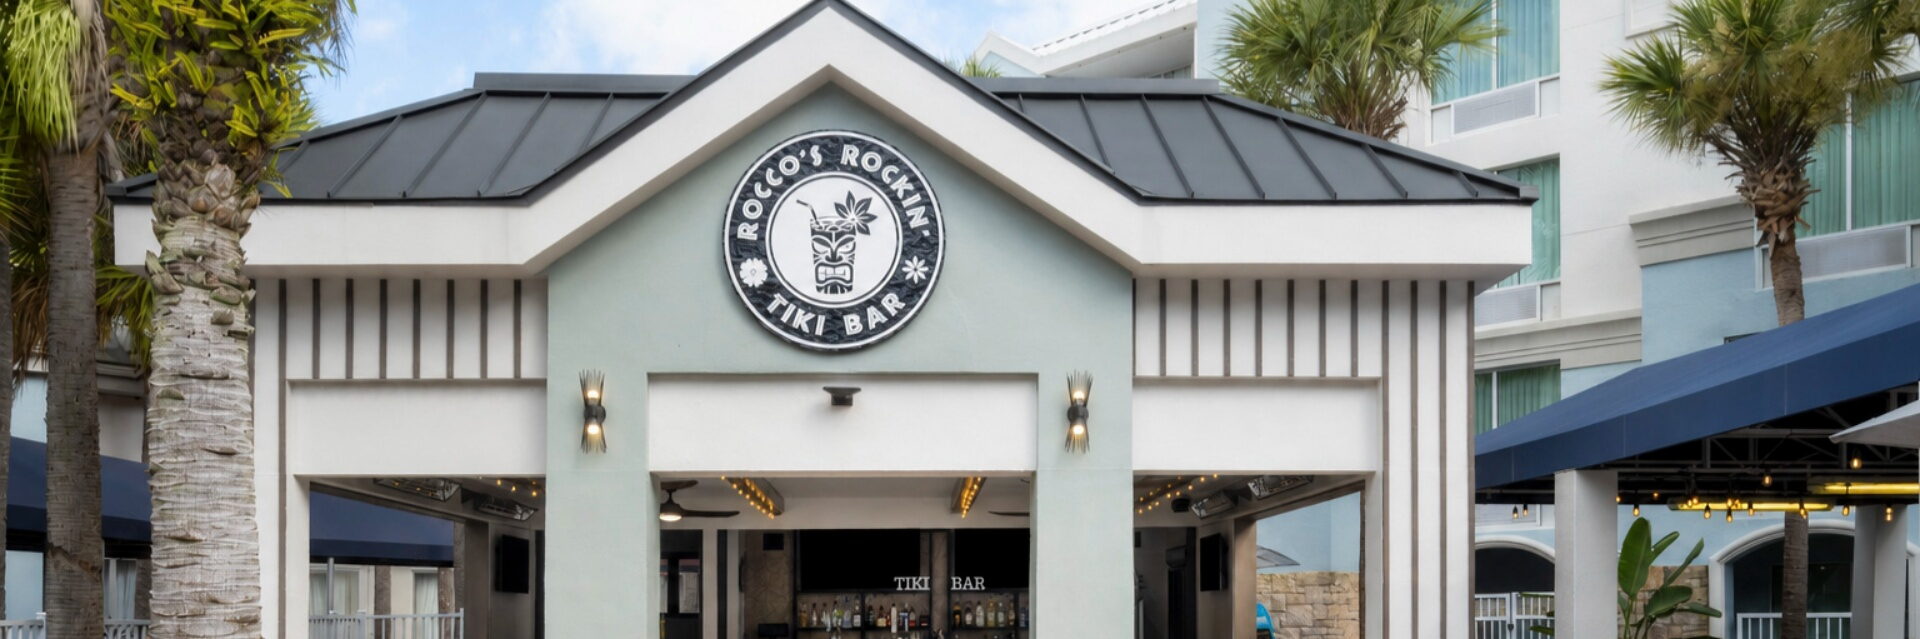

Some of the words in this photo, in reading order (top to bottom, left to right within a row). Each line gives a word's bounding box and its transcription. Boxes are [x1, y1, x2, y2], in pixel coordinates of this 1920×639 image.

[737, 145, 823, 240] ROCCO'S
[840, 144, 930, 237] ROCKIN'
[767, 293, 826, 336] TIKI
[843, 293, 906, 335] BAR
[893, 576, 931, 591] TIKI
[950, 576, 986, 591] BAR
